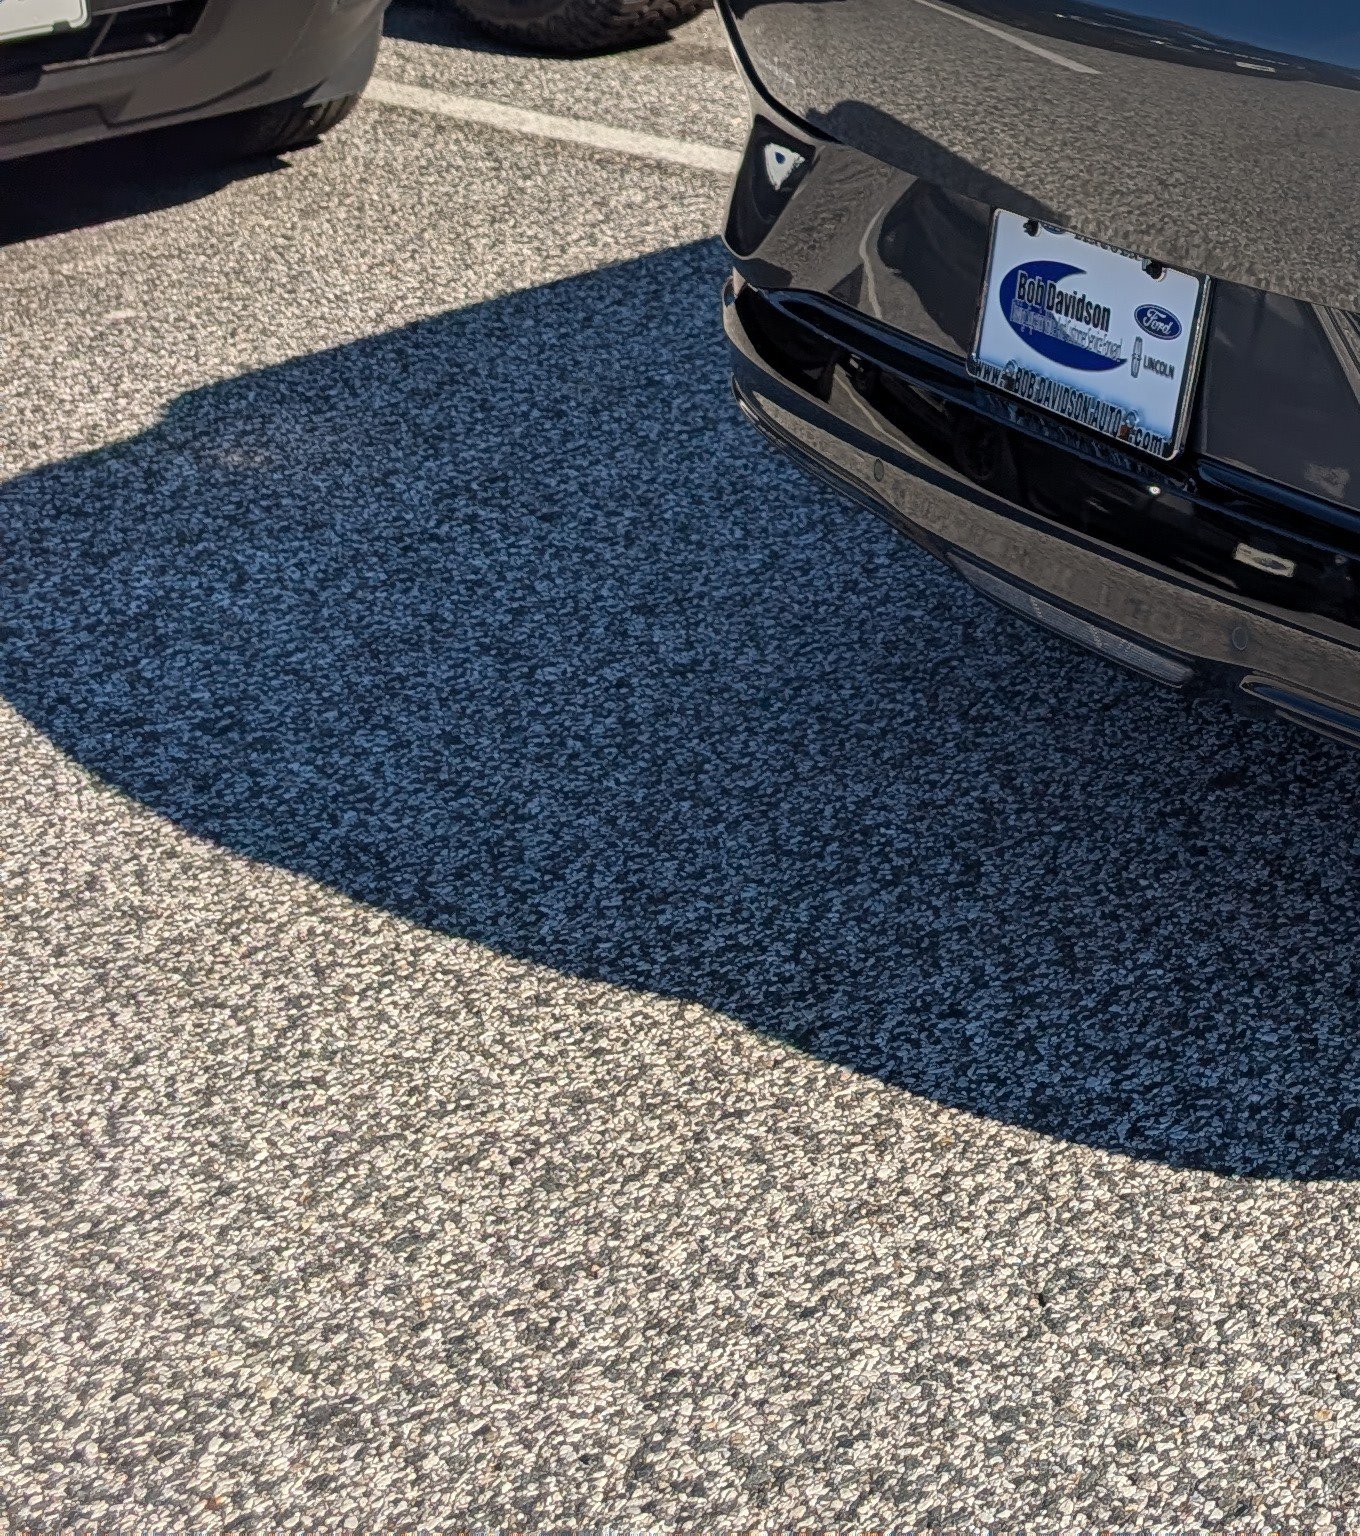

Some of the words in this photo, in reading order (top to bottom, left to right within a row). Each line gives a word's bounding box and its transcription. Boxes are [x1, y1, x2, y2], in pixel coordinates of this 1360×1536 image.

[1017, 272, 1044, 305] Bob
[1046, 282, 1111, 332] Davidson
[1143, 308, 1173, 334] Ford
[1143, 355, 1175, 380] LINCOLN
